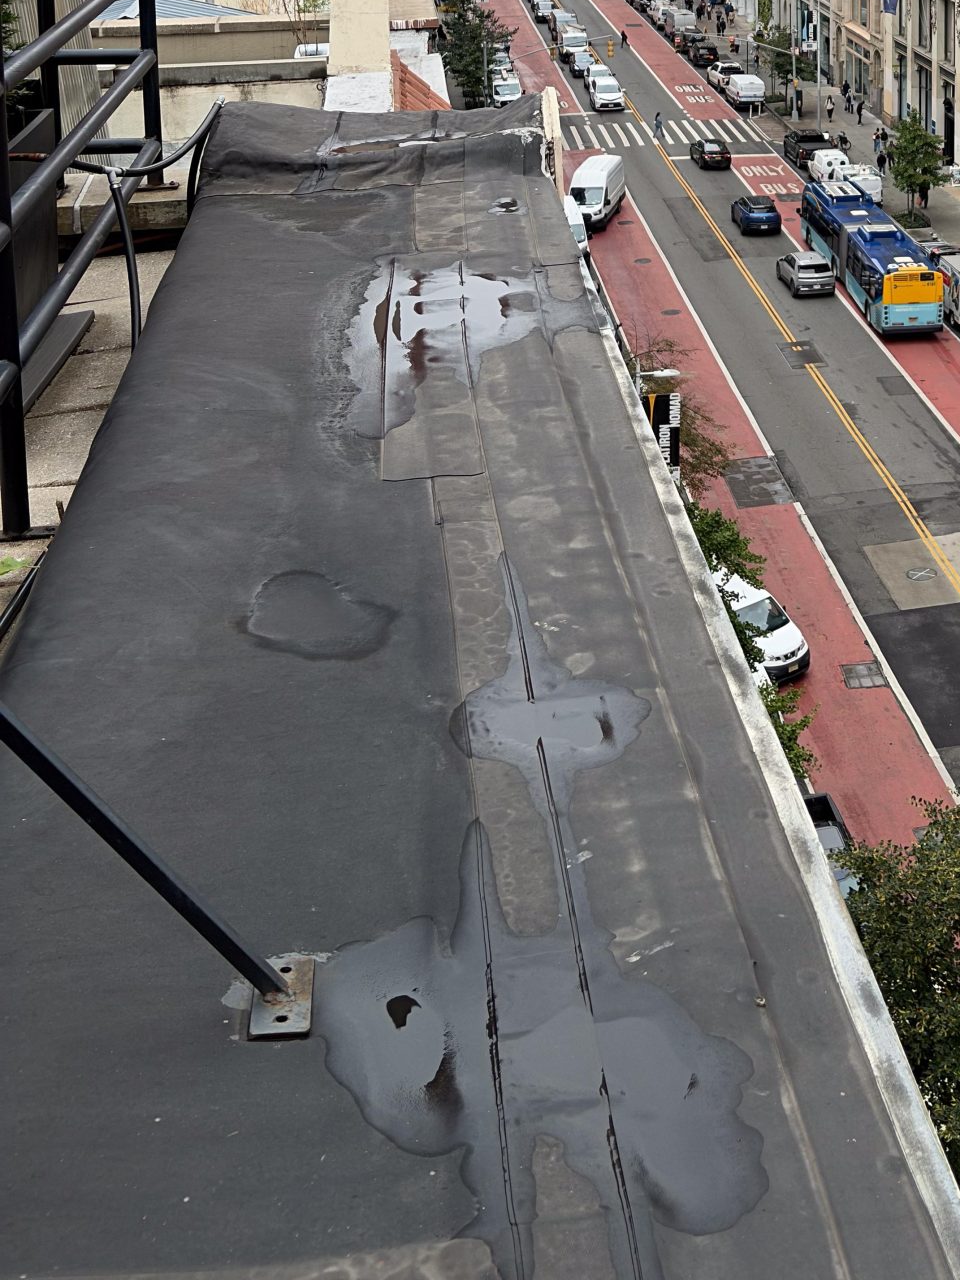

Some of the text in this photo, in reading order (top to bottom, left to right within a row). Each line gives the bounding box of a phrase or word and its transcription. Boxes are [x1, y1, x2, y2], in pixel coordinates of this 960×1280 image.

[674, 84, 706, 93] ONLY
[685, 95, 715, 103] BUS
[741, 163, 784, 178] ONLY
[759, 183, 800, 196] BUS
[669, 392, 680, 428] NOMAD
